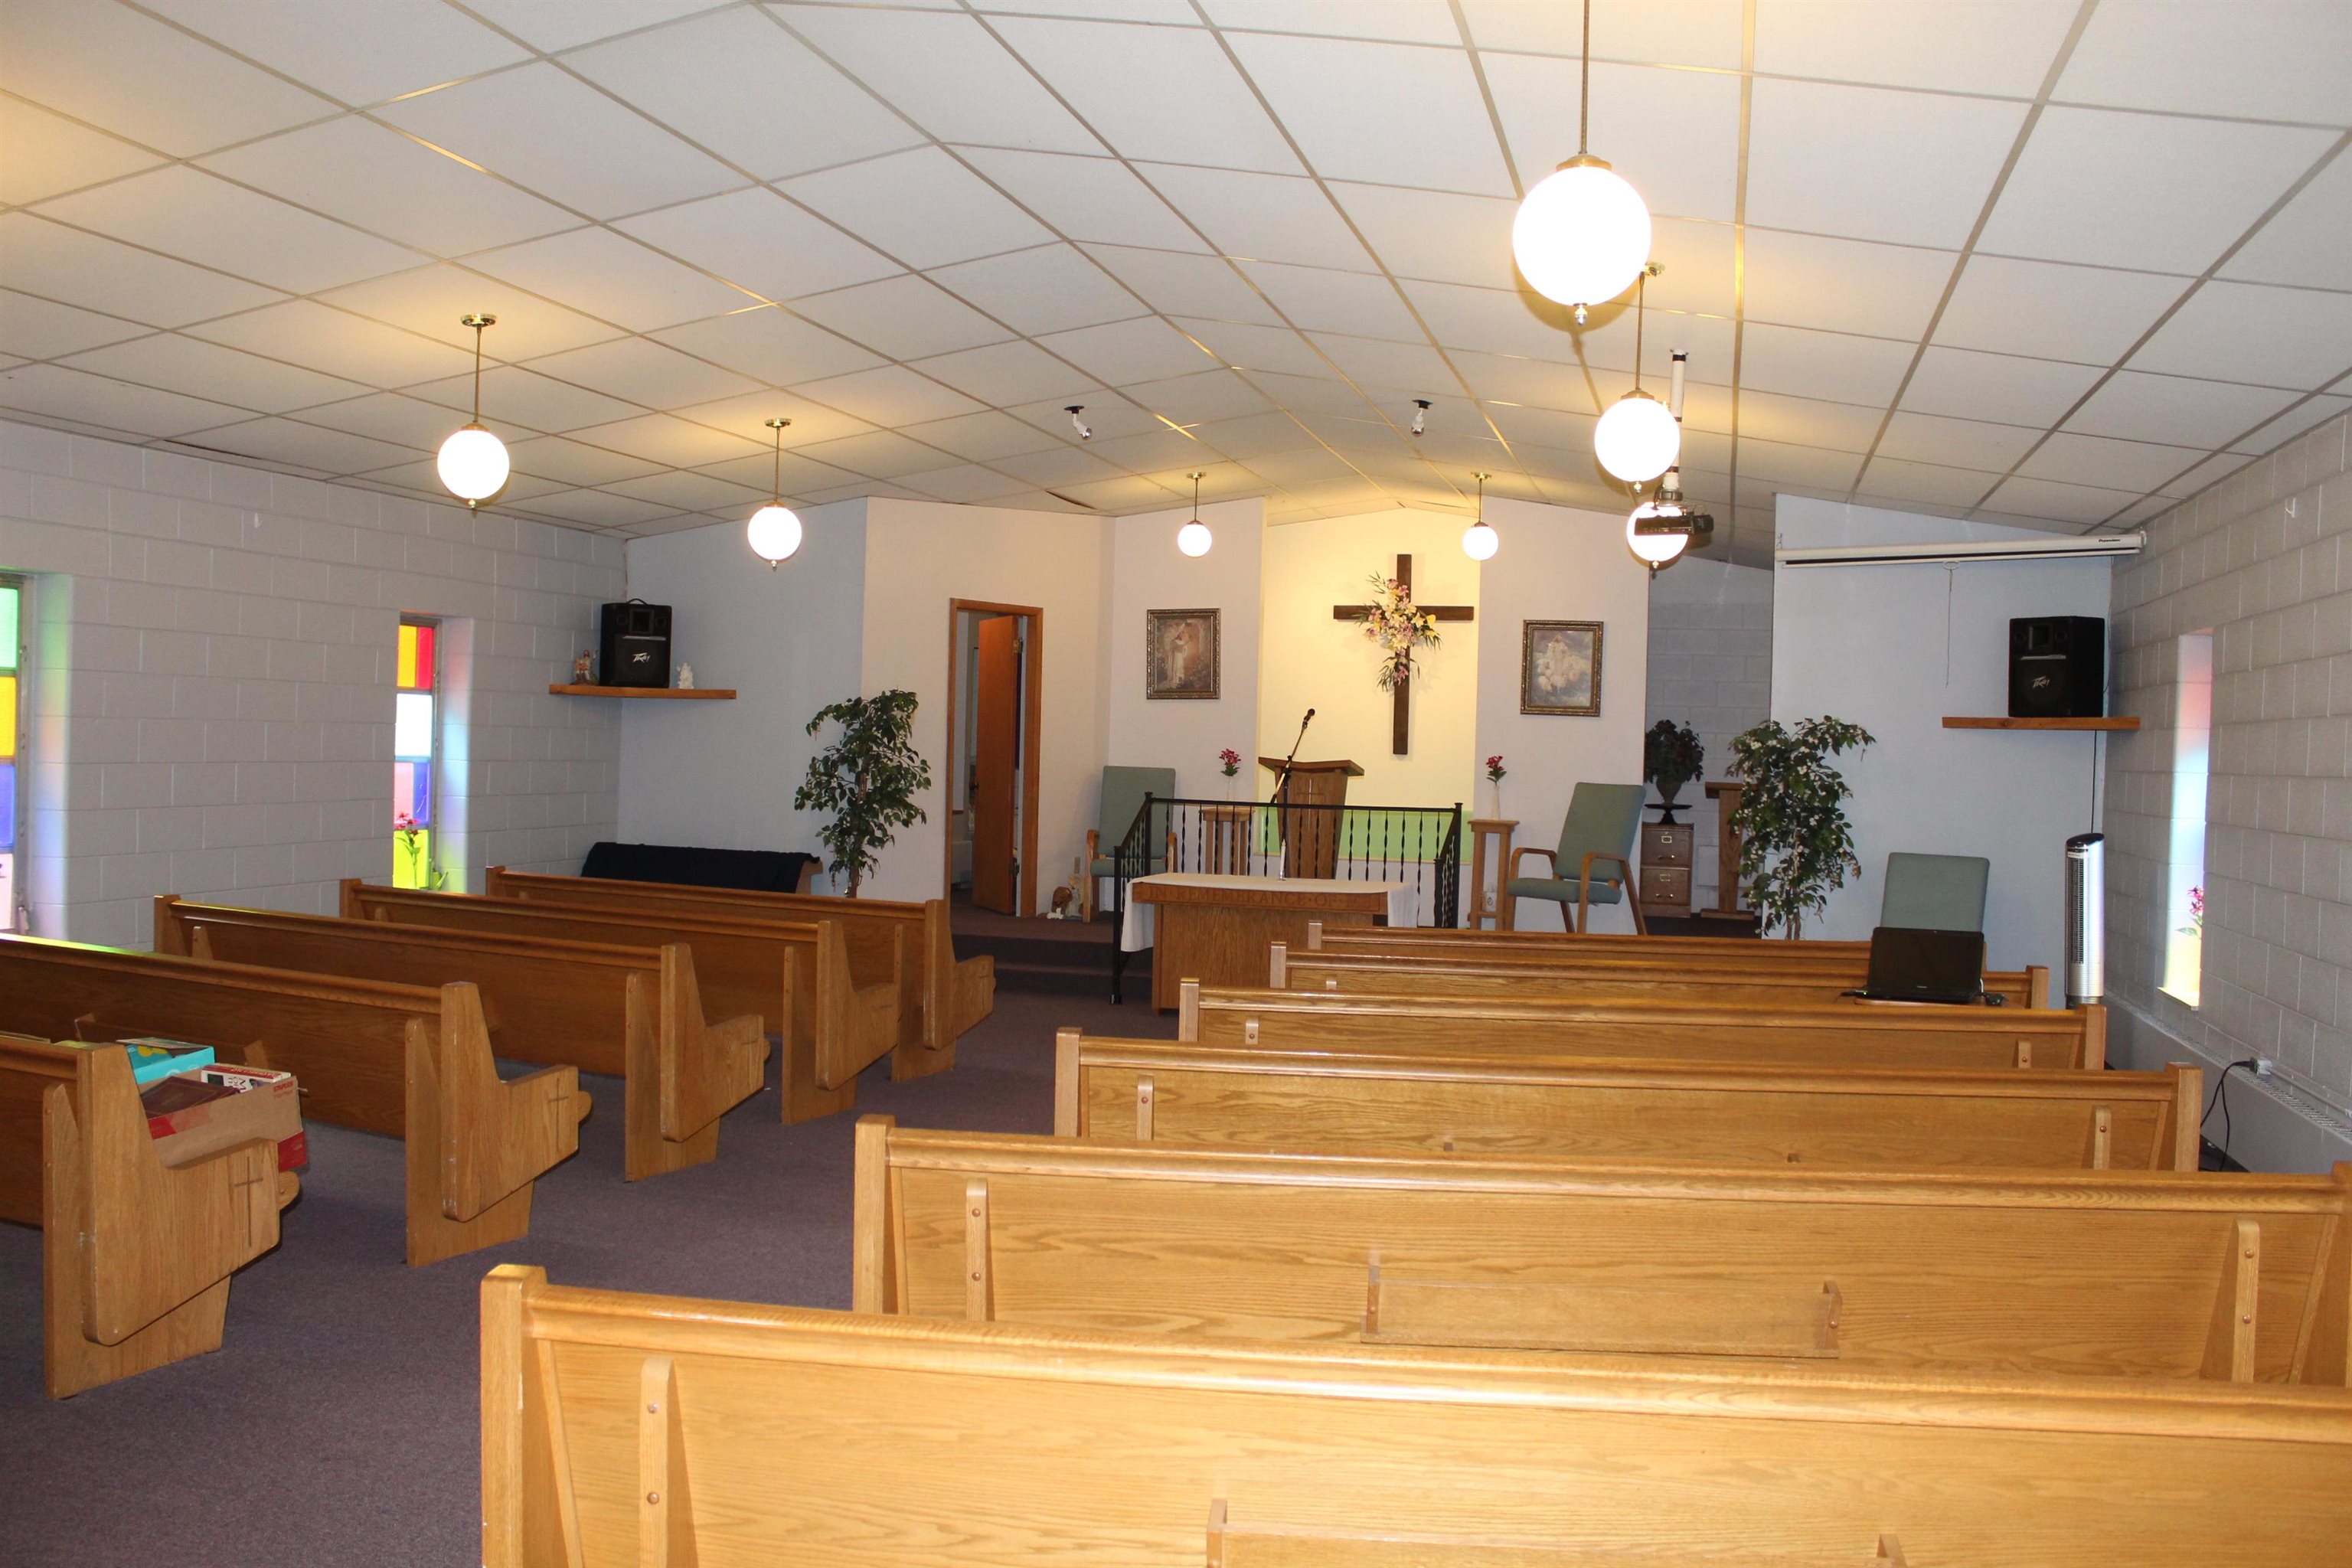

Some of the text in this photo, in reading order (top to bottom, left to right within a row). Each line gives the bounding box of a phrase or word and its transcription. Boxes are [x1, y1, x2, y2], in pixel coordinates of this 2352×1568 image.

[1148, 885, 1166, 899] IN
[1176, 887, 1306, 905] REMEMBRANCE
[1314, 894, 1338, 906] OF
